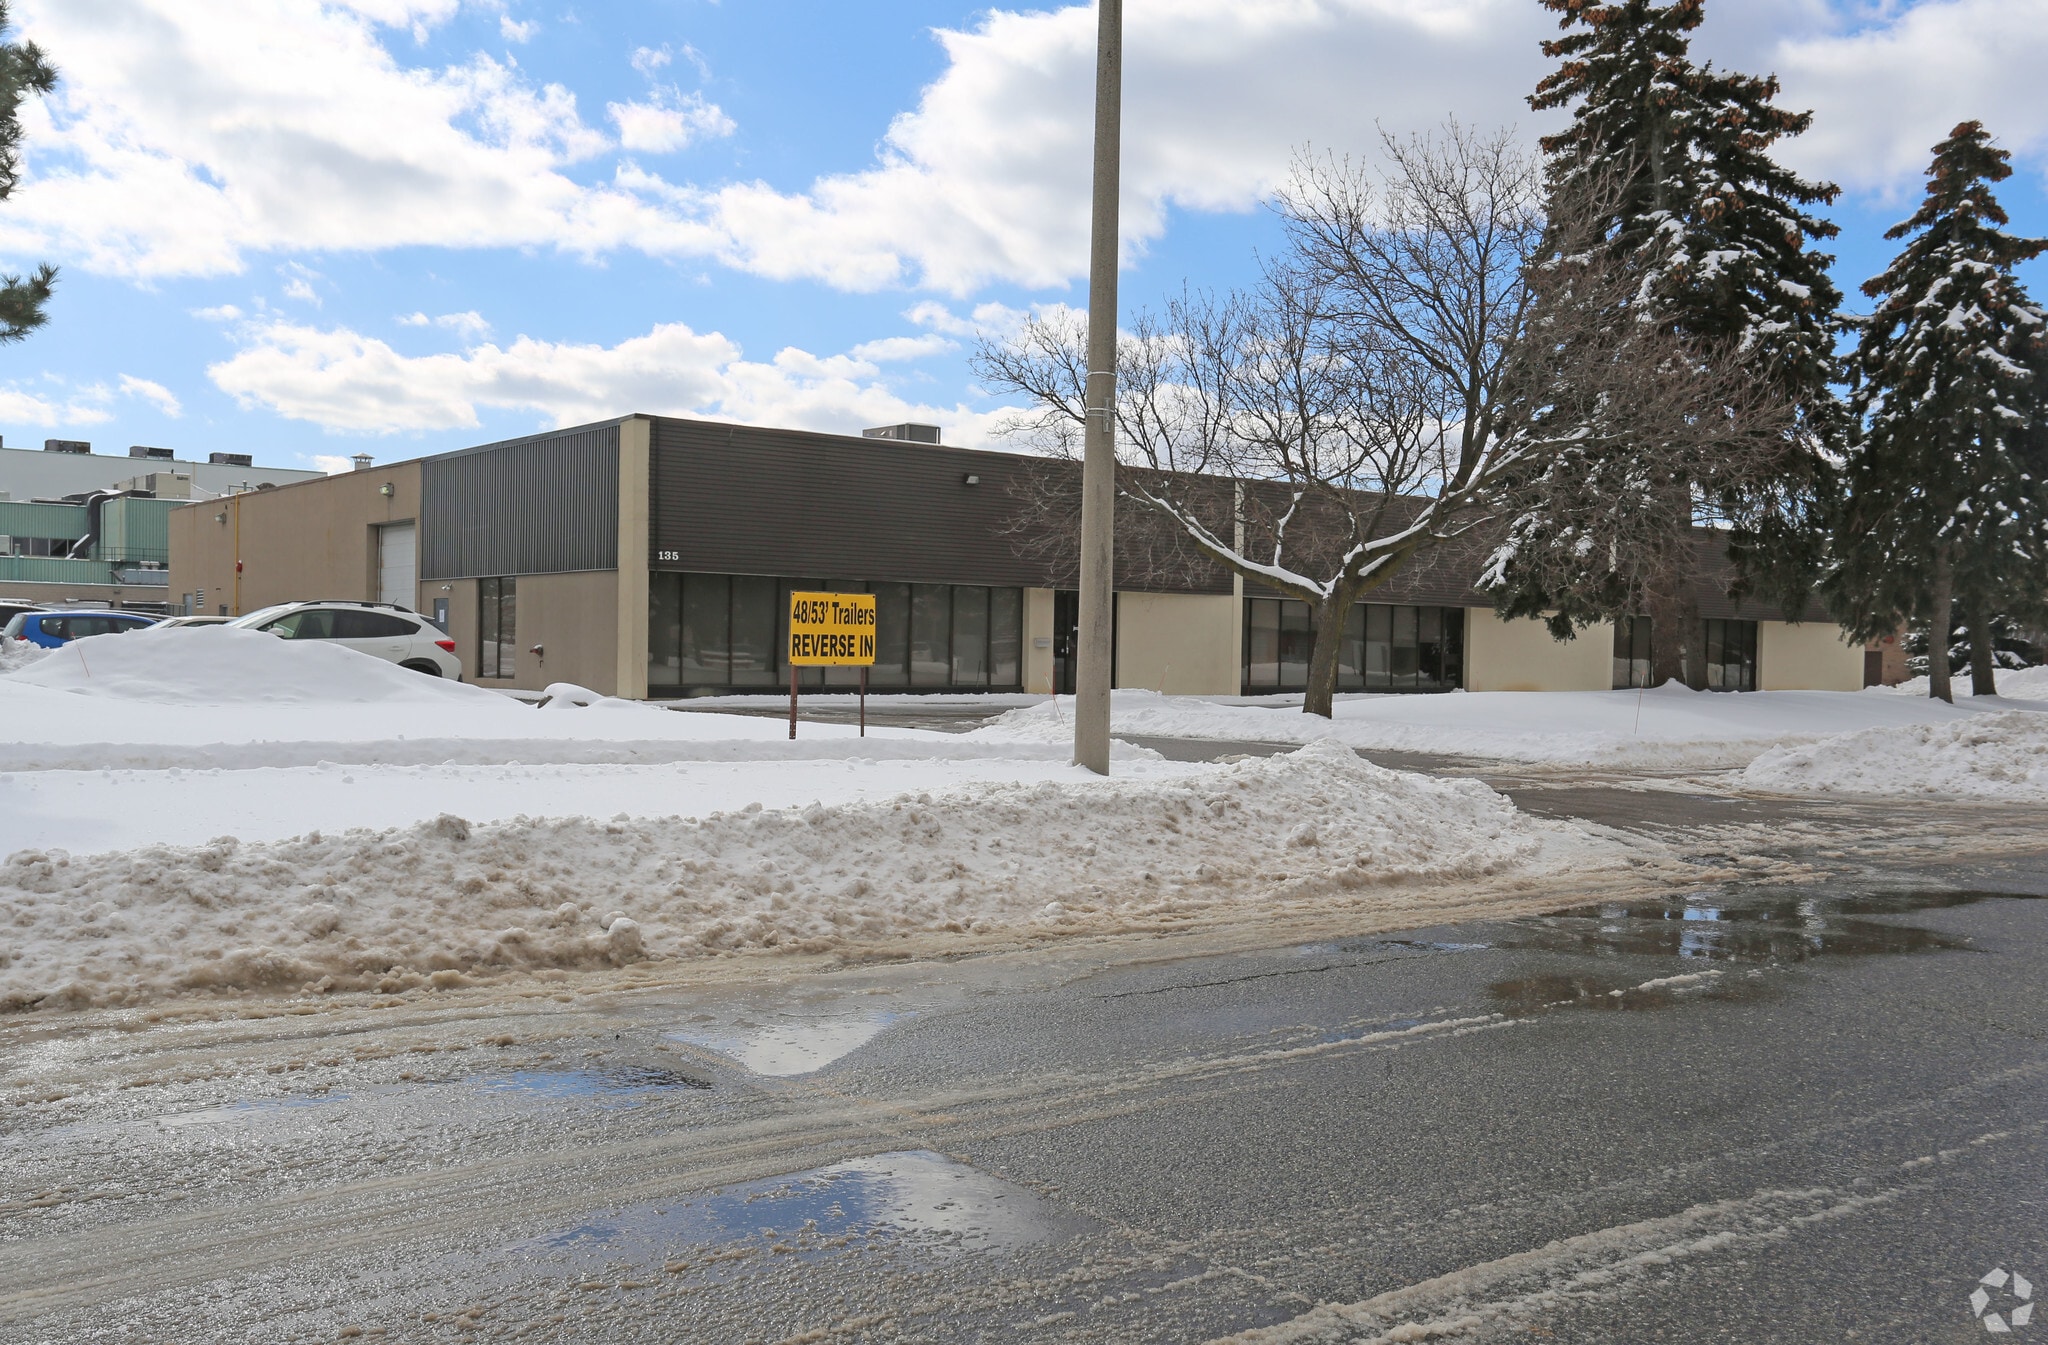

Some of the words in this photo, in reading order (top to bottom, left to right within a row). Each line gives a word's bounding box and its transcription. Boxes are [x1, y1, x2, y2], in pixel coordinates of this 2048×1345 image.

[658, 551, 679, 560] 135
[832, 602, 875, 625] Trailers
[792, 634, 855, 657] REVERSE
[860, 635, 873, 657] IN
